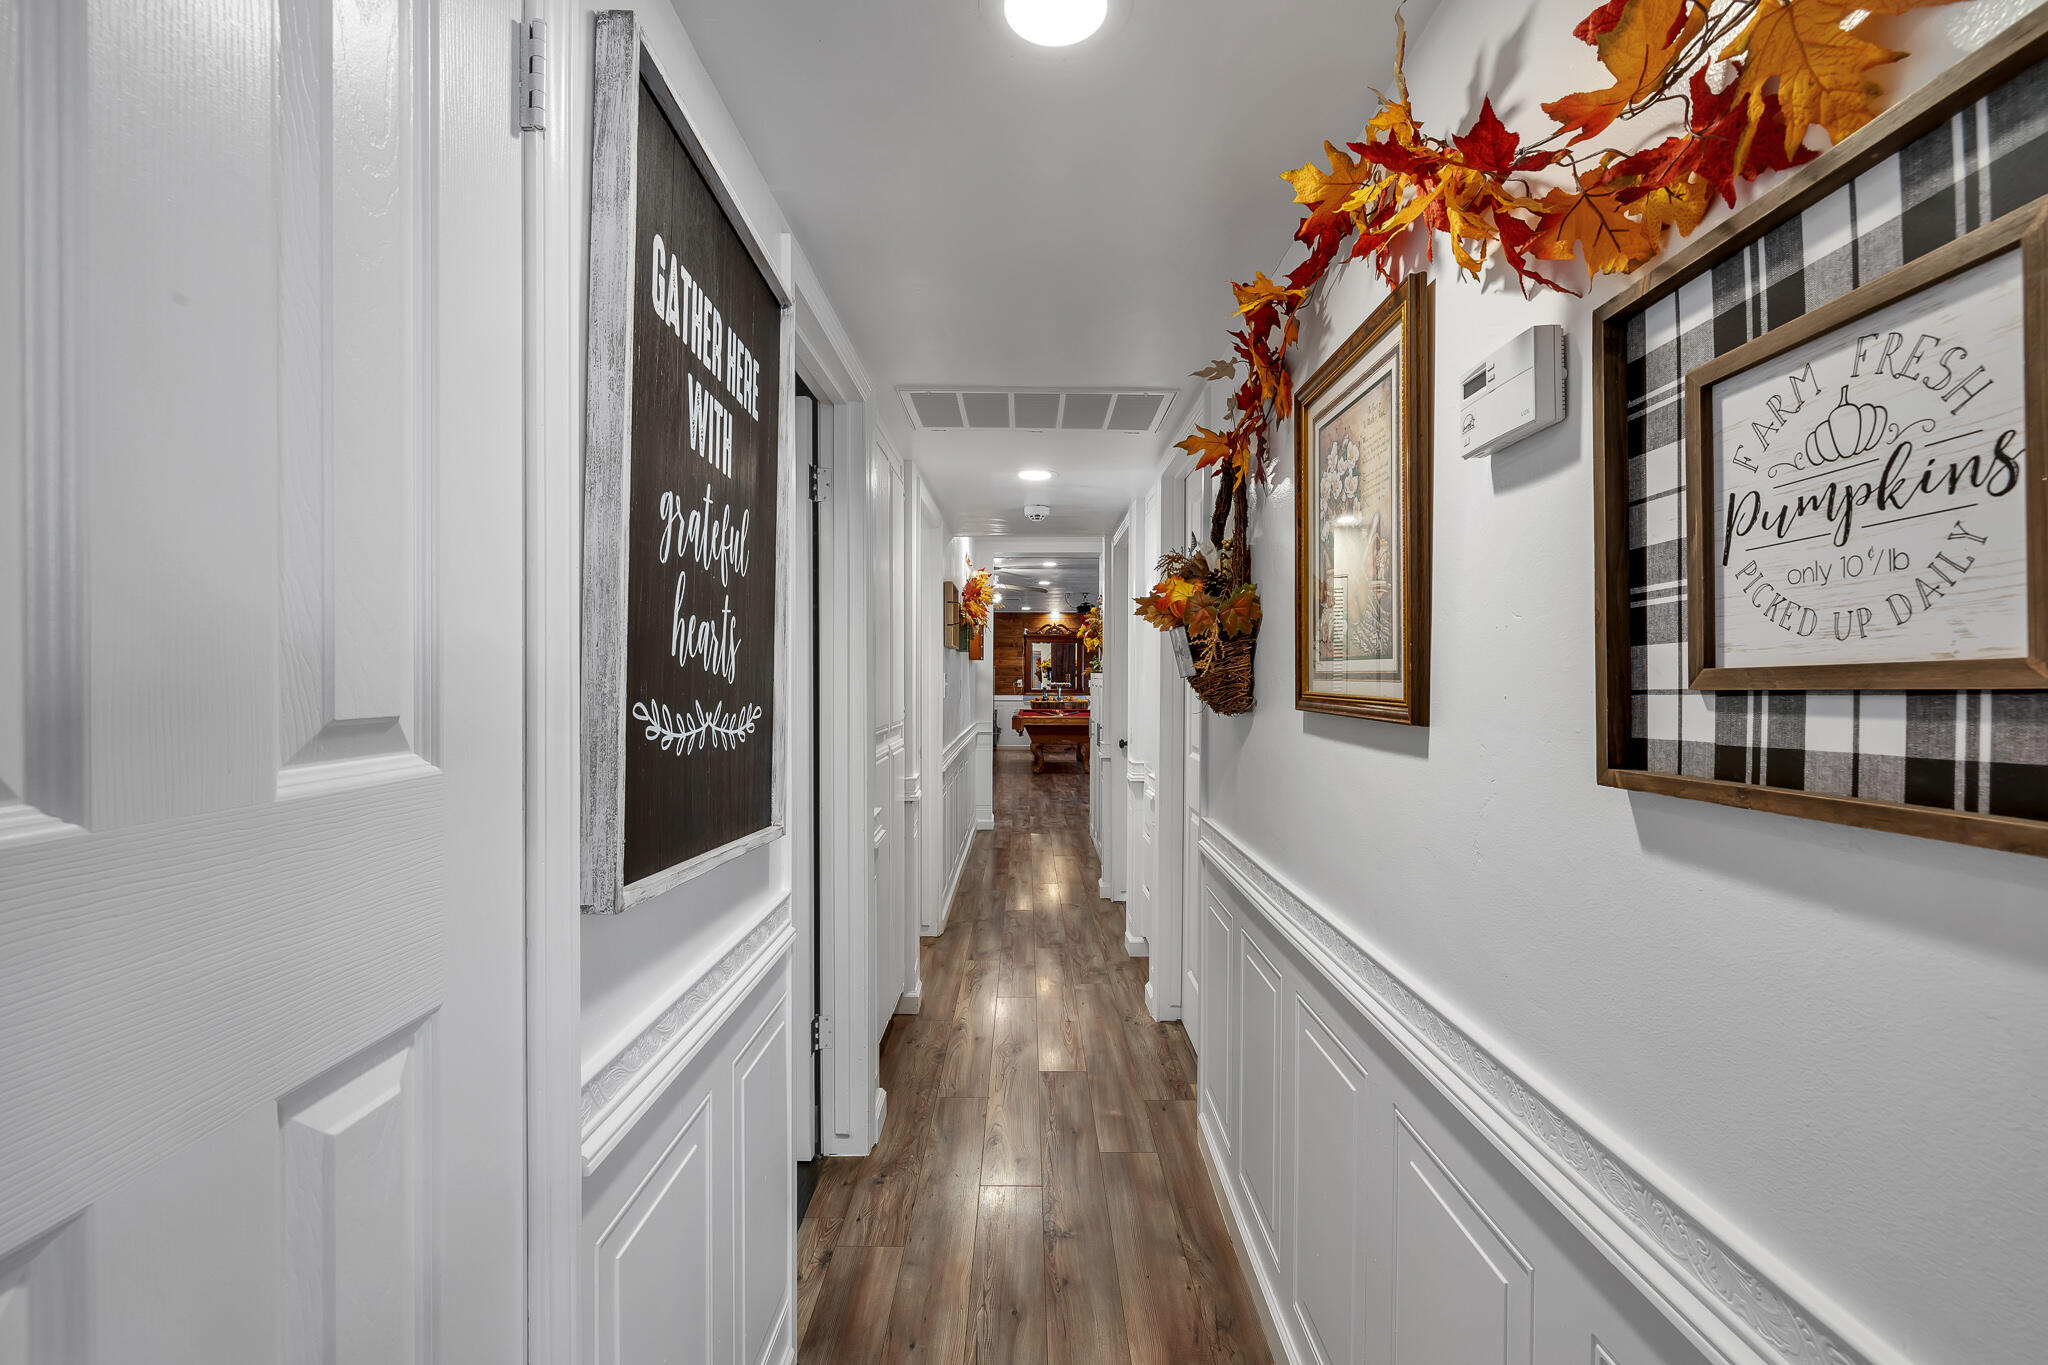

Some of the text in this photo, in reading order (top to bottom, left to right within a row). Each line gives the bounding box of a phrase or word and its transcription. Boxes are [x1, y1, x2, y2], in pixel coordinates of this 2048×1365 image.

[651, 233, 760, 422] GATHER HERE
[687, 372, 733, 479] WITH
[1732, 332, 1994, 474] FARM FRESH
[659, 483, 750, 588] grateful
[1734, 520, 1989, 641] PICKED UP DAILY
[1787, 560, 1833, 586] only
[671, 570, 742, 685] hearts
